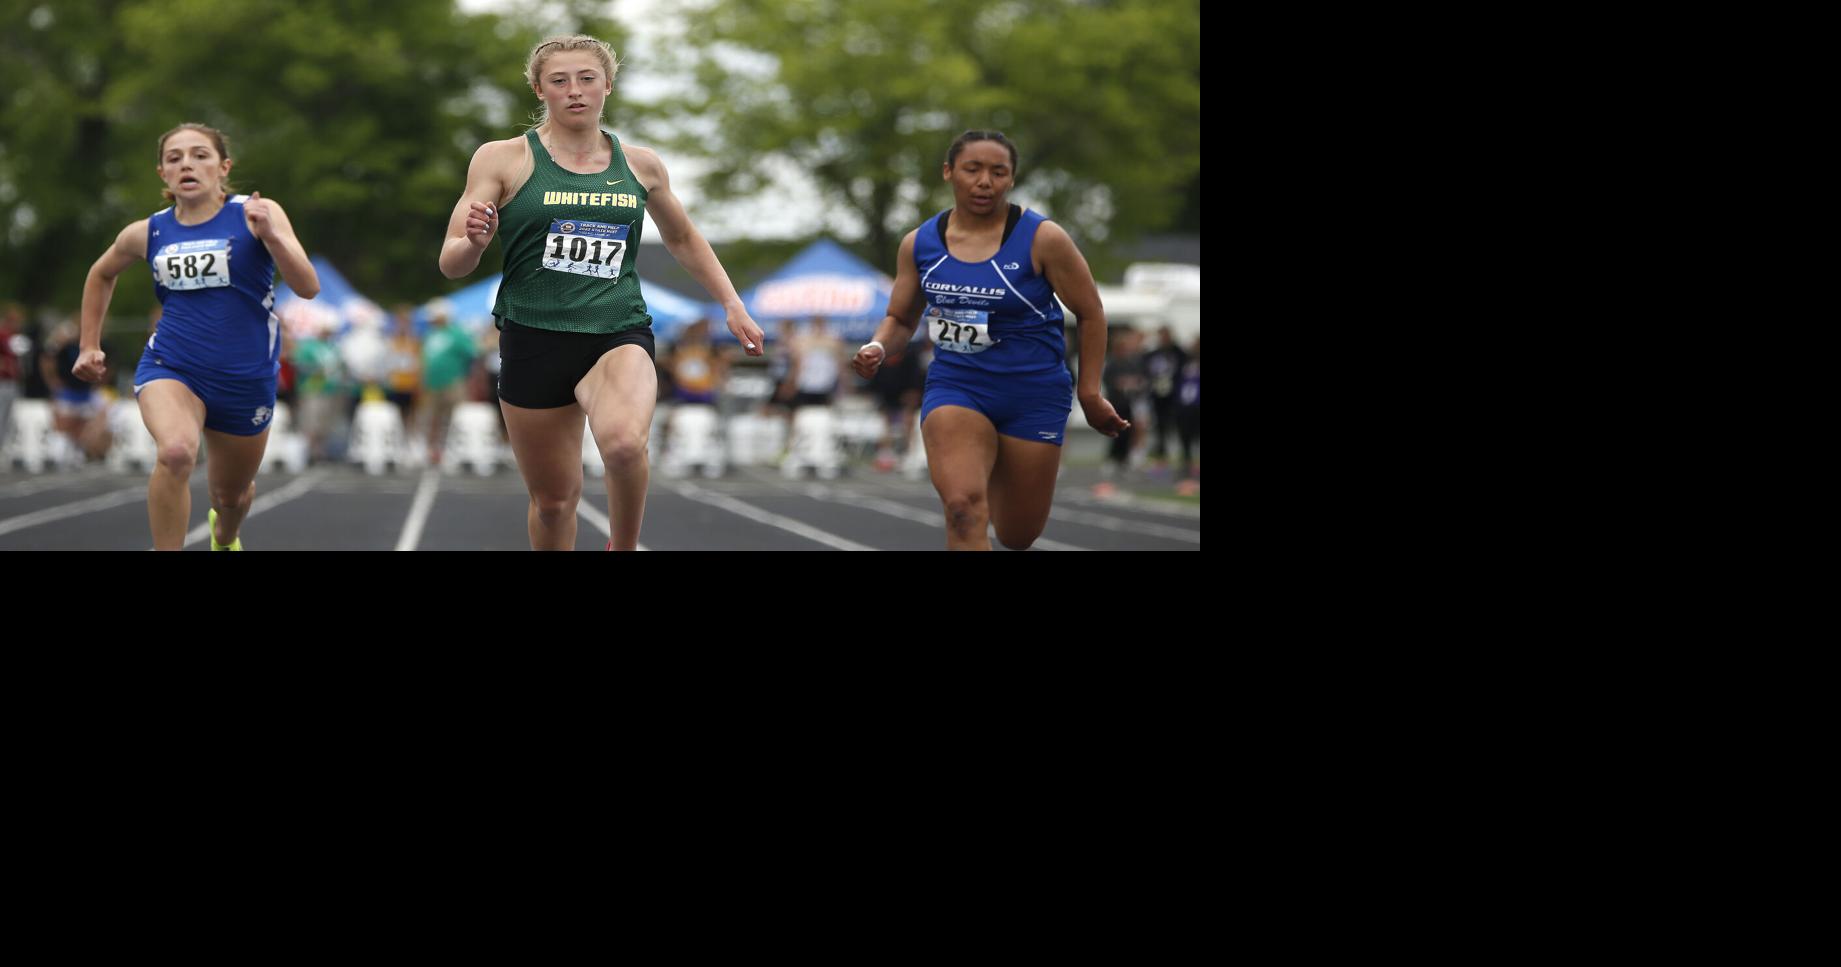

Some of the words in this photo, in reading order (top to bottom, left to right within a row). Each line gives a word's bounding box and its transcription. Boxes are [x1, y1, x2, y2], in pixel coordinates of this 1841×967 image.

[543, 191, 637, 208] WHITEFISH
[550, 235, 622, 266] 1017
[167, 253, 217, 279] 582
[925, 281, 1006, 295] CORVALLIS
[935, 295, 955, 305] Blue
[958, 296, 990, 306] Devils
[937, 319, 983, 346] 272
